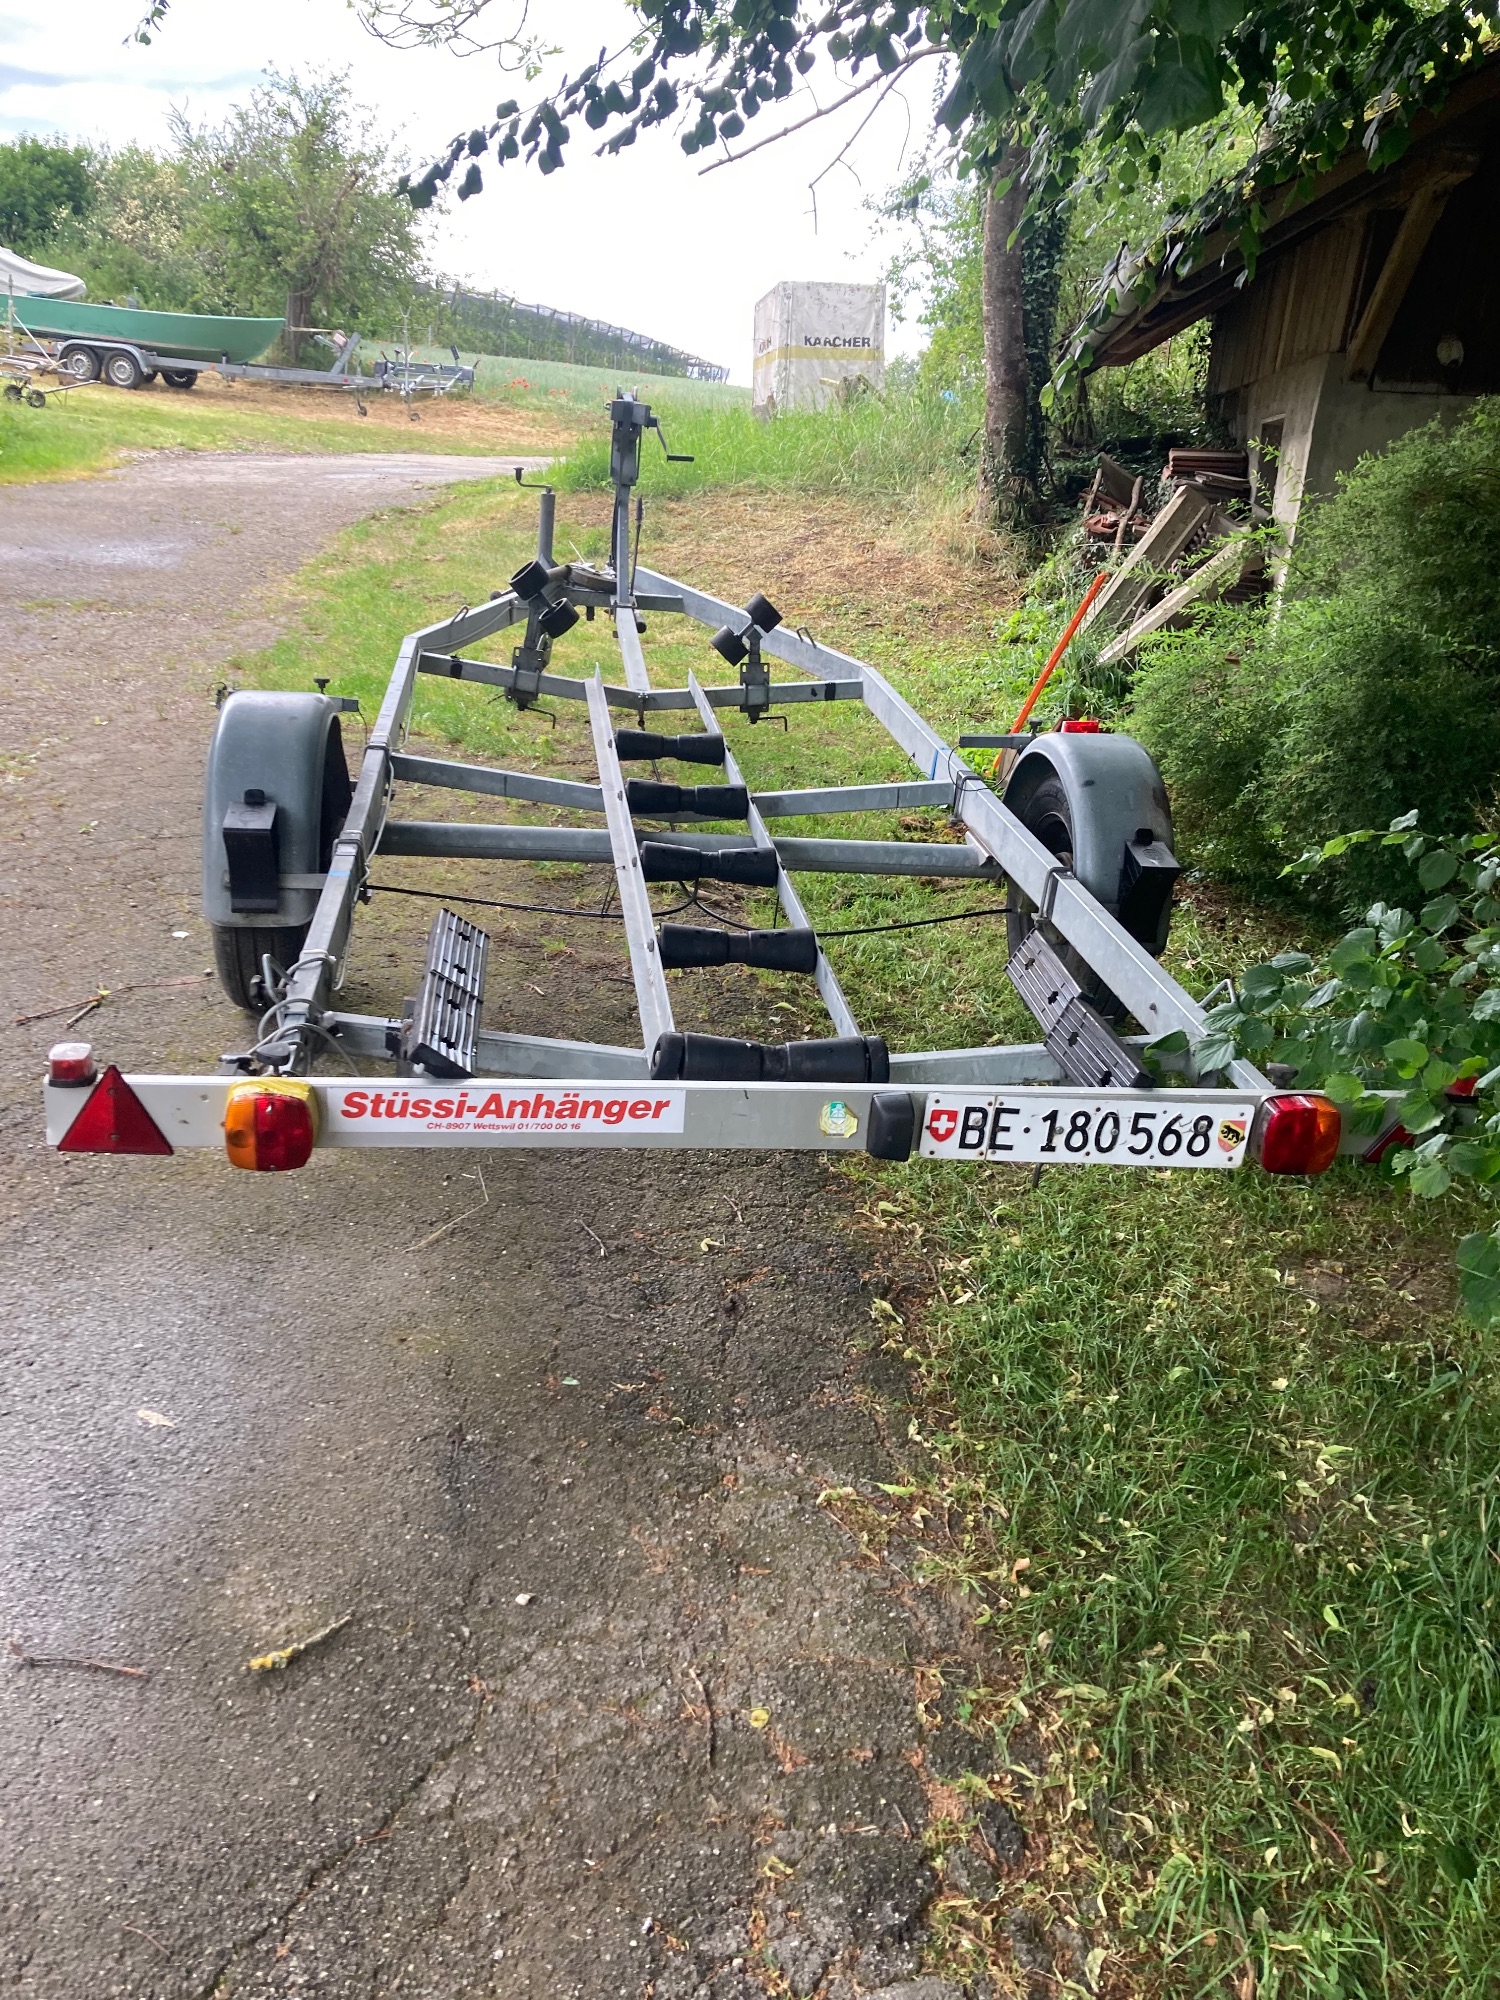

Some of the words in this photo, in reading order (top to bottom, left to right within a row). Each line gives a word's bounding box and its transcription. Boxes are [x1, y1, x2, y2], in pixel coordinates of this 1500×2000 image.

[340, 1091, 672, 1126] Stüssi-Anhänger
[426, 1122, 471, 1130] CH-8907
[473, 1122, 515, 1130] Wettswil
[517, 1122, 553, 1130] 01/700
[555, 1122, 567, 1130] 00
[570, 1122, 581, 1130] 16
[1039, 1109, 1214, 1158] 180568
